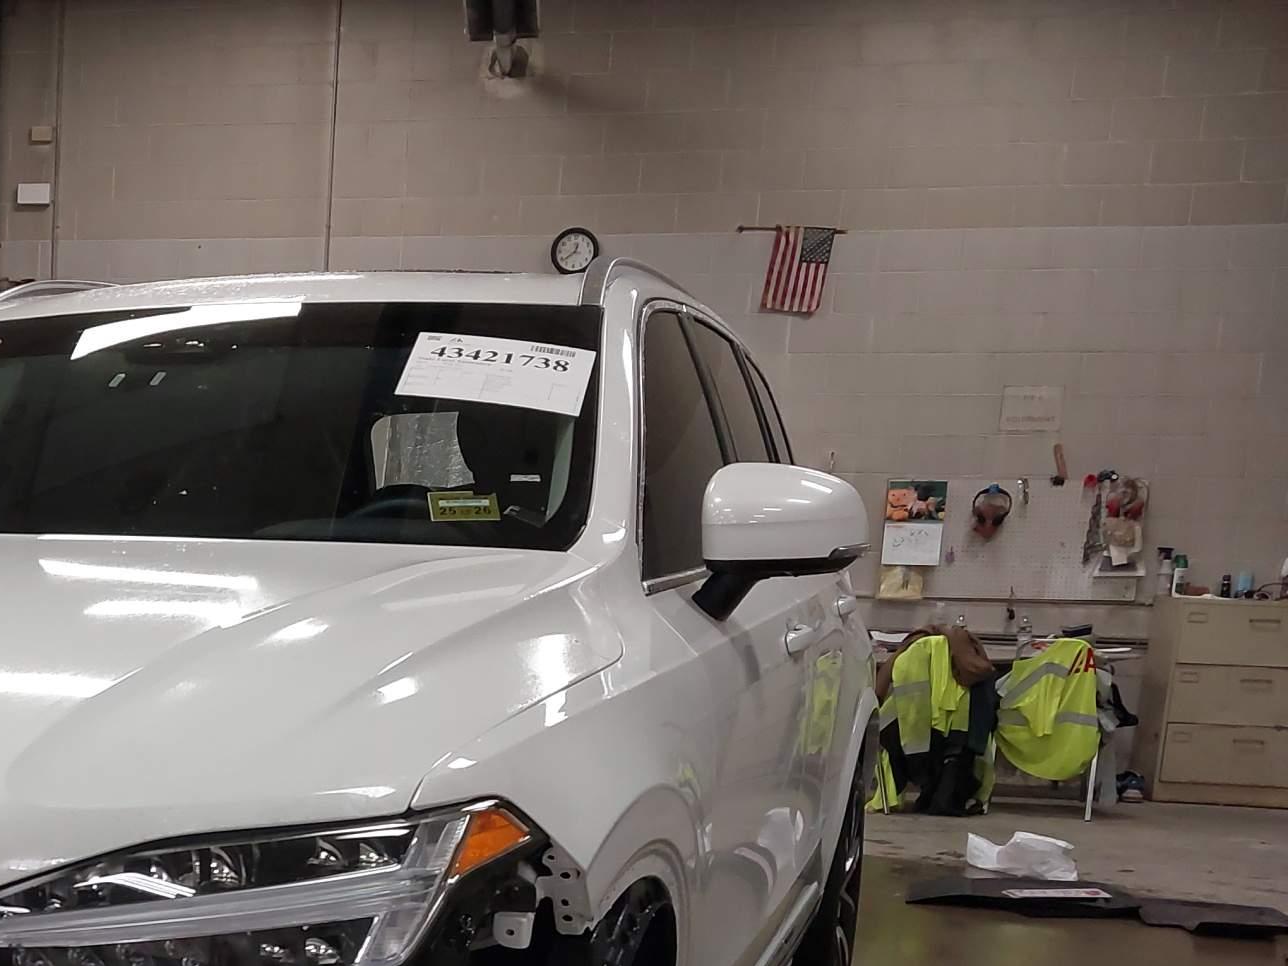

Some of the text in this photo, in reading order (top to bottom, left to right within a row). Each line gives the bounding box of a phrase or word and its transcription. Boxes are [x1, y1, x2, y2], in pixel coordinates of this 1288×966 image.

[430, 346, 570, 373] 43421738
[439, 506, 457, 516] 25
[474, 506, 492, 515] 26
